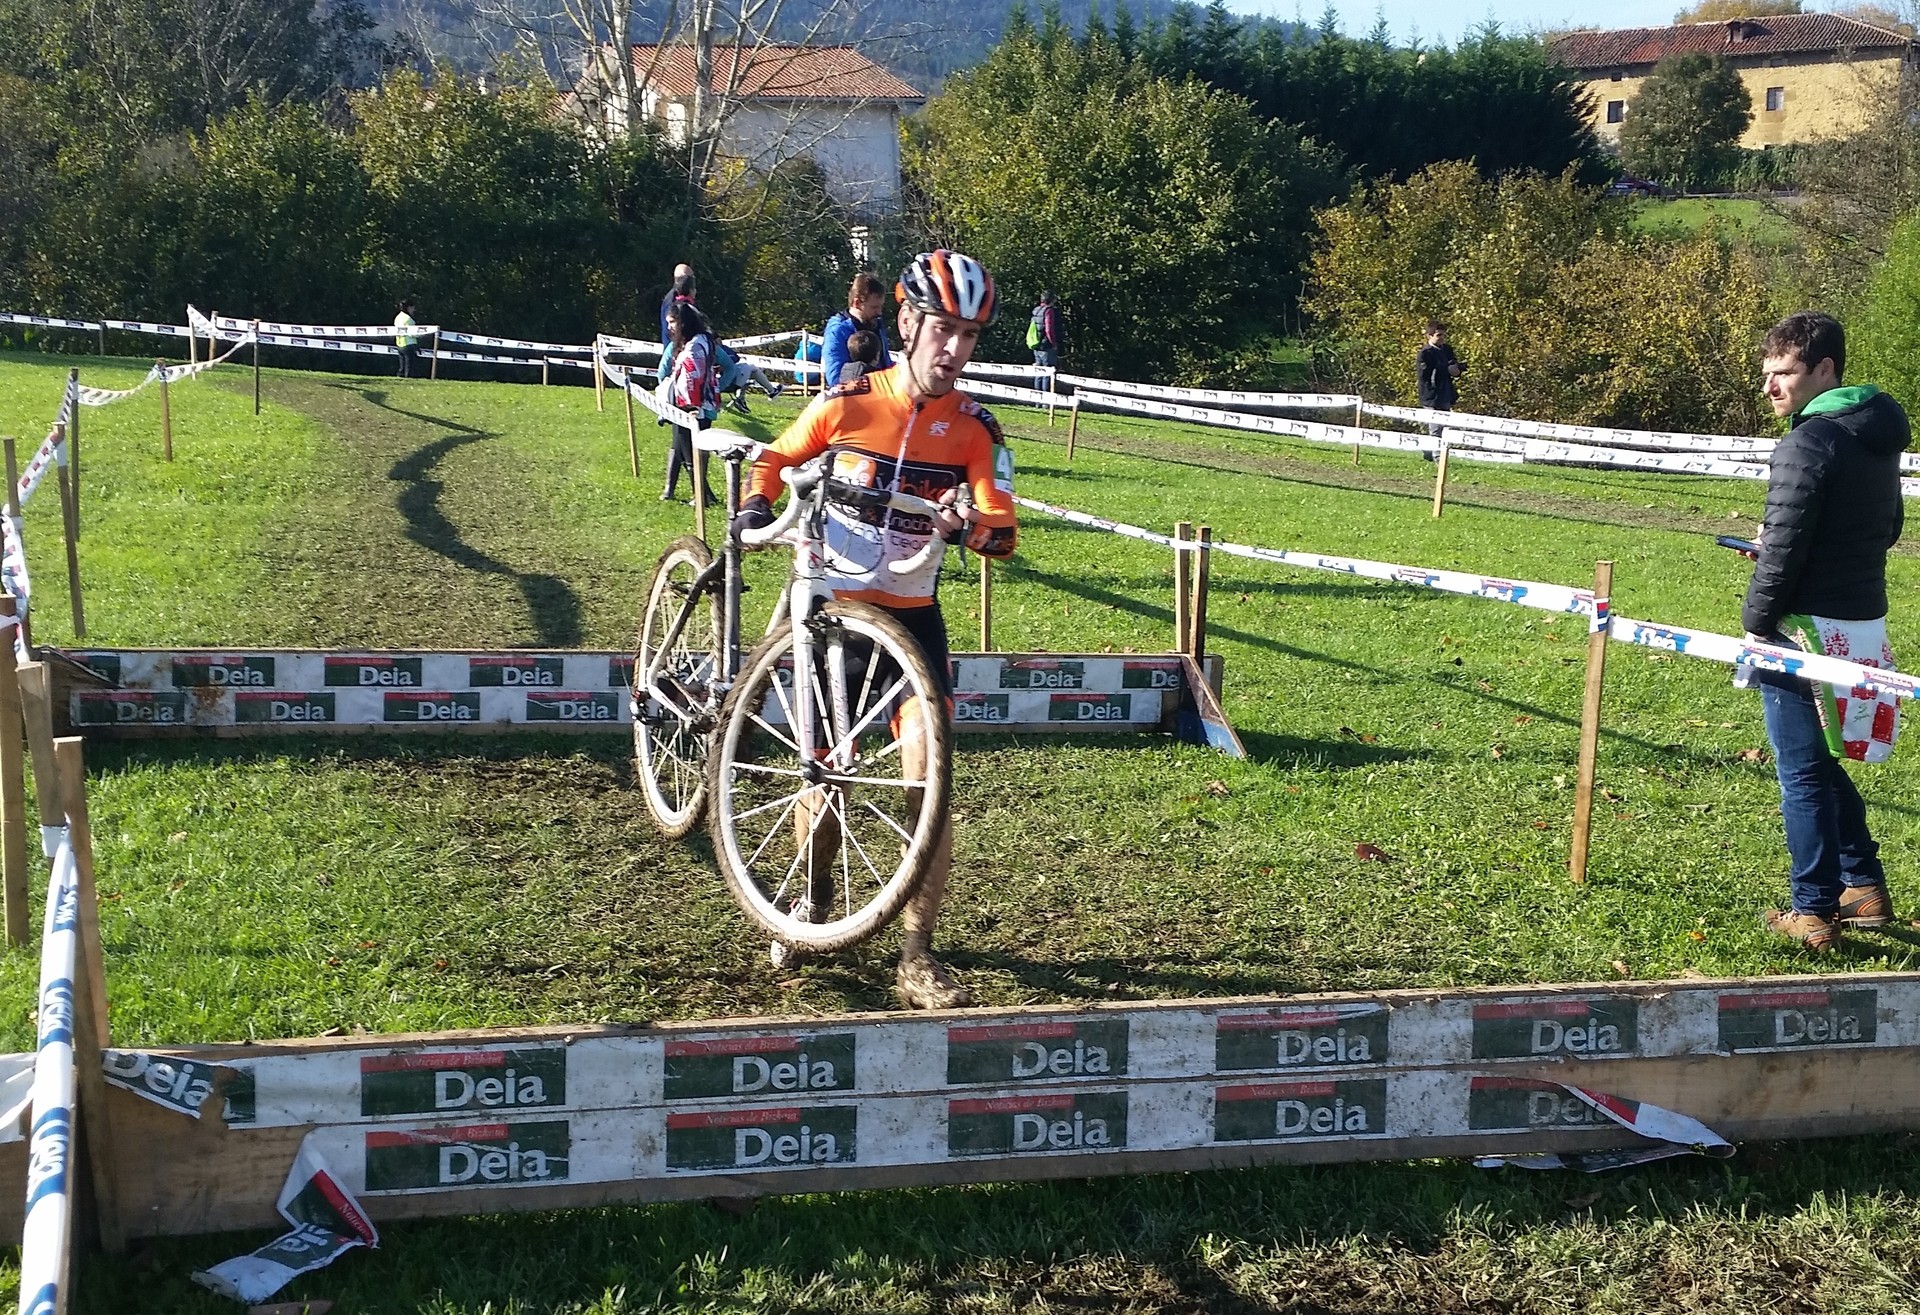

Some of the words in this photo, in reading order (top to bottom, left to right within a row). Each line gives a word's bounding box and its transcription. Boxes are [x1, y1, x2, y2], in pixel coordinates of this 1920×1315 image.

[209, 666, 266, 685] Deia
[359, 666, 413, 685] Deia
[502, 667, 554, 685] Deia
[1029, 669, 1074, 687] Deia
[1151, 670, 1179, 687] De
[116, 702, 175, 721] Deia
[270, 701, 326, 720] Deia
[417, 701, 471, 720] Deia
[559, 701, 610, 720] Deia
[955, 702, 1001, 720] Deia
[1078, 702, 1123, 720] Deia
[1531, 1017, 1622, 1054] Deia
[1775, 1008, 1862, 1044] Deia
[1012, 1039, 1111, 1078] Deia
[1277, 1028, 1372, 1065] Deia
[102, 1049, 214, 1107] Deia
[435, 1068, 547, 1109] Deia
[732, 1052, 838, 1093] Deia
[1275, 1098, 1369, 1136] Deia
[1529, 1091, 1607, 1124] Dei
[734, 1125, 840, 1166] Deia
[1012, 1110, 1111, 1150] Deia
[439, 1141, 551, 1184] Deia
